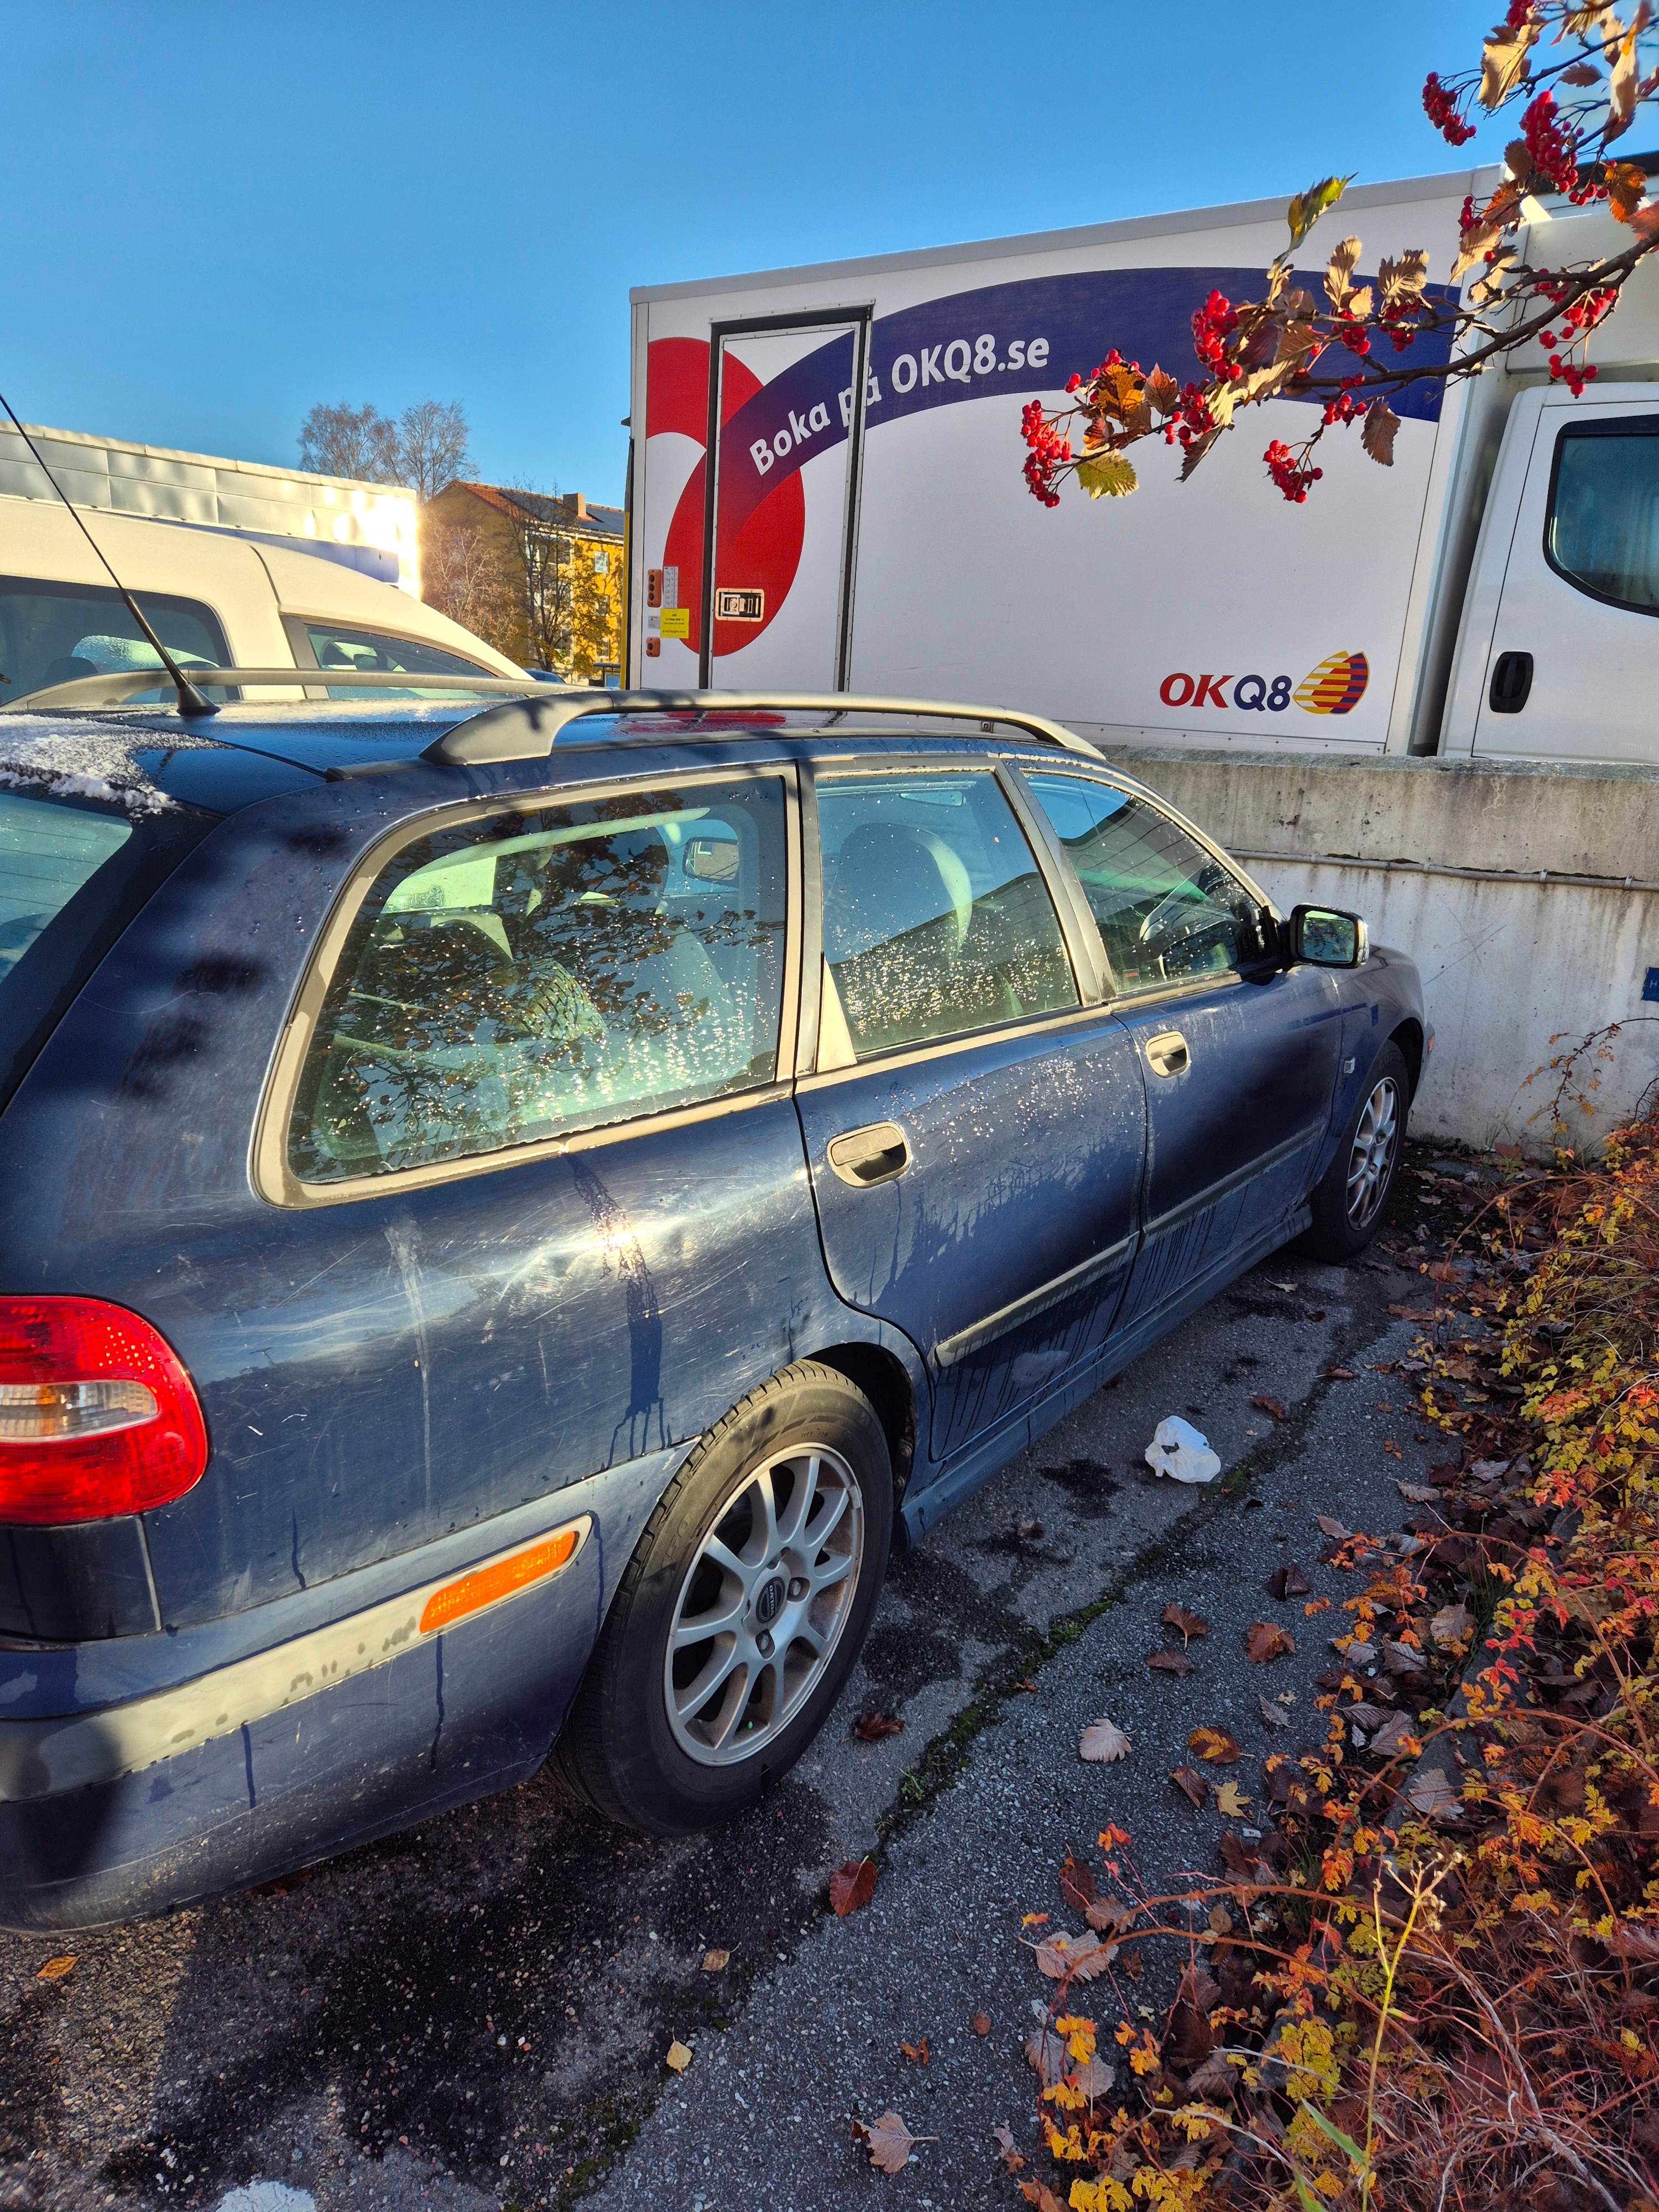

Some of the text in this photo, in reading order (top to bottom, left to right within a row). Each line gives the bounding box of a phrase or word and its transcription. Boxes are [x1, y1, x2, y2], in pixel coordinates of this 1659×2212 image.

[749, 333, 1050, 476] Boka på OKQ8.se
[1160, 672, 1292, 712] OKQ8
